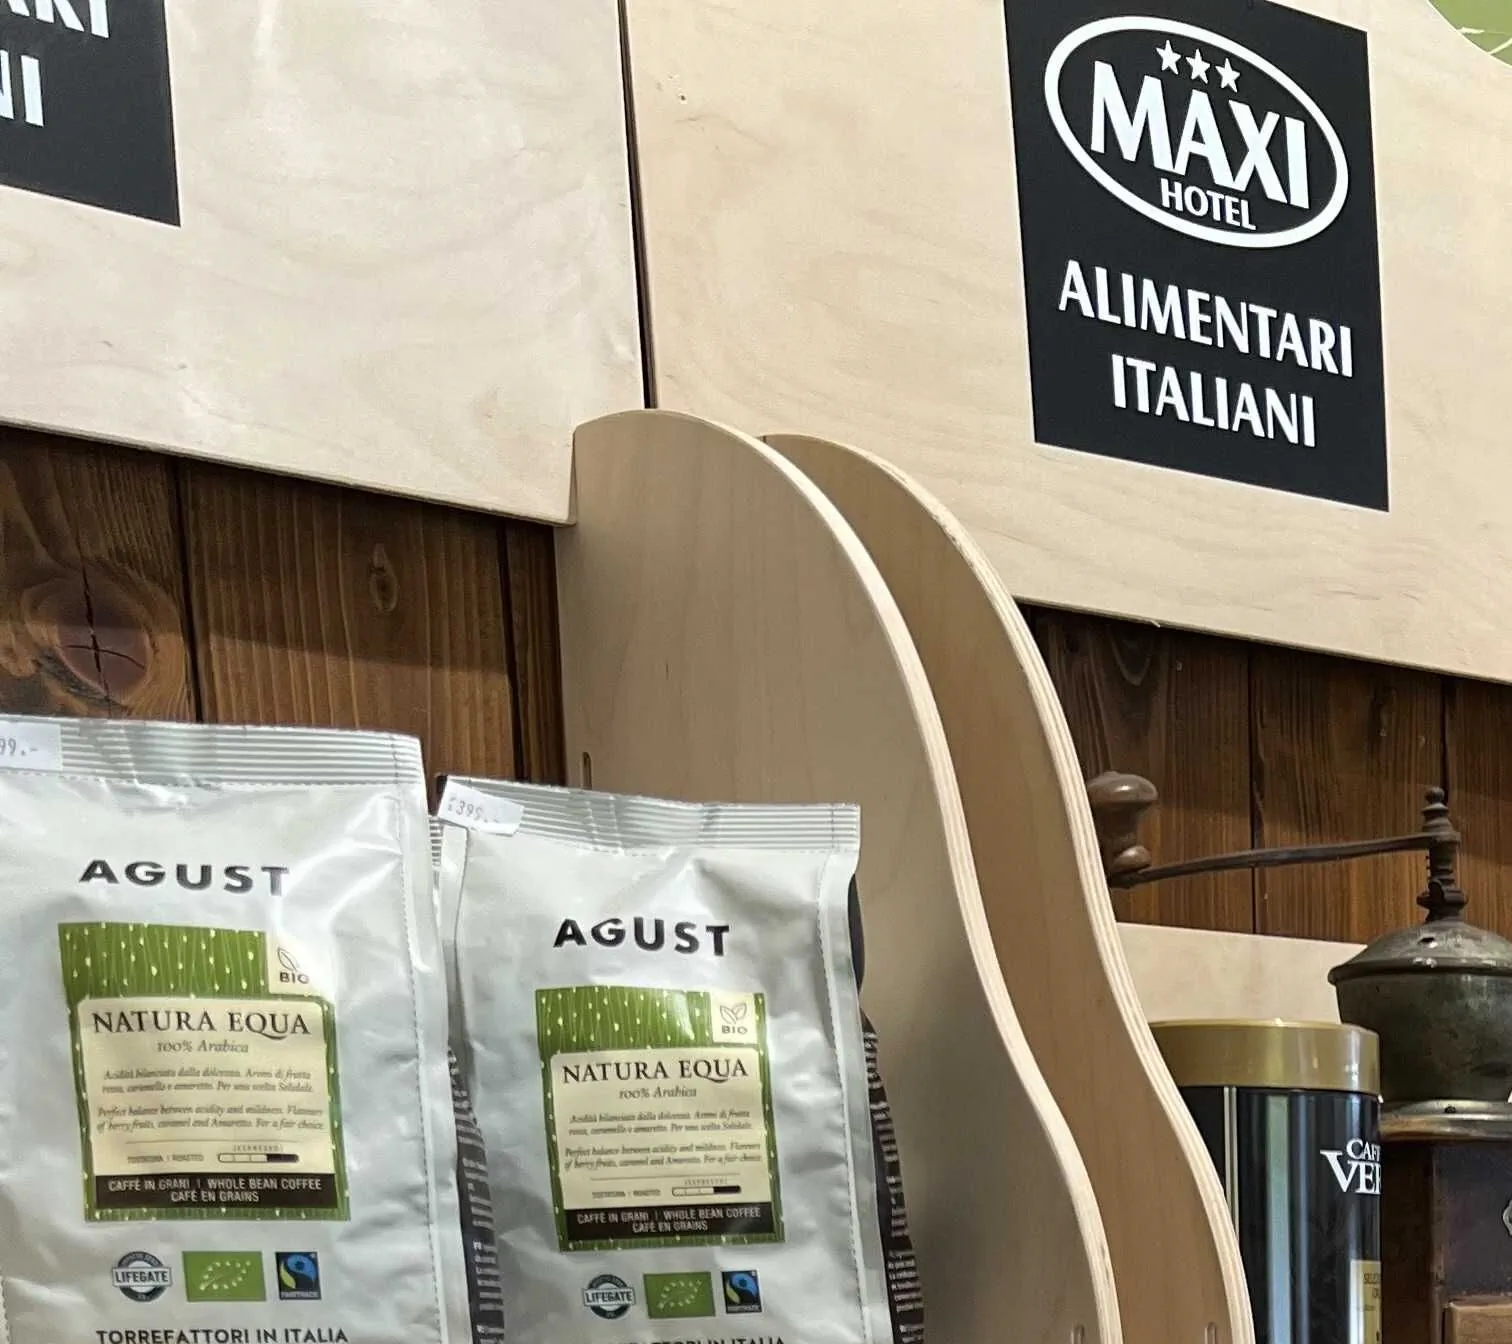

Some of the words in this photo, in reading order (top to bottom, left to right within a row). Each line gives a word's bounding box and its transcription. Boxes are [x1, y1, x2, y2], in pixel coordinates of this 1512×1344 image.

[1090, 61, 1309, 209] MAXI
[1161, 178, 1256, 230] HOTEL
[1058, 259, 1353, 377] ALIMENTARI
[1112, 353, 1316, 447] ITALIANI
[79, 859, 290, 896] AGUST
[553, 918, 730, 957] AGUST
[92, 1010, 217, 1034] NATURA
[227, 1012, 312, 1040] EQUA
[721, 1025, 748, 1035] BIO
[197, 1040, 249, 1053] Arabica
[563, 1061, 670, 1084] NATURA
[679, 1059, 748, 1083] EQUA
[653, 1086, 697, 1098] Arabica
[207, 1178, 245, 1190] WHOLE
[249, 1178, 278, 1190] BEAN
[281, 1178, 322, 1189] COFFEE
[663, 1210, 696, 1221] WHOLE
[699, 1209, 724, 1219] BEAN
[726, 1207, 760, 1218] COFFEE
[115, 1270, 169, 1283] LIFEGATE
[586, 1289, 633, 1303] LIFEGATE
[96, 1329, 249, 1344] TORREFATTORI
[257, 1329, 277, 1343] IN
[284, 1328, 349, 1343] ITALIA
